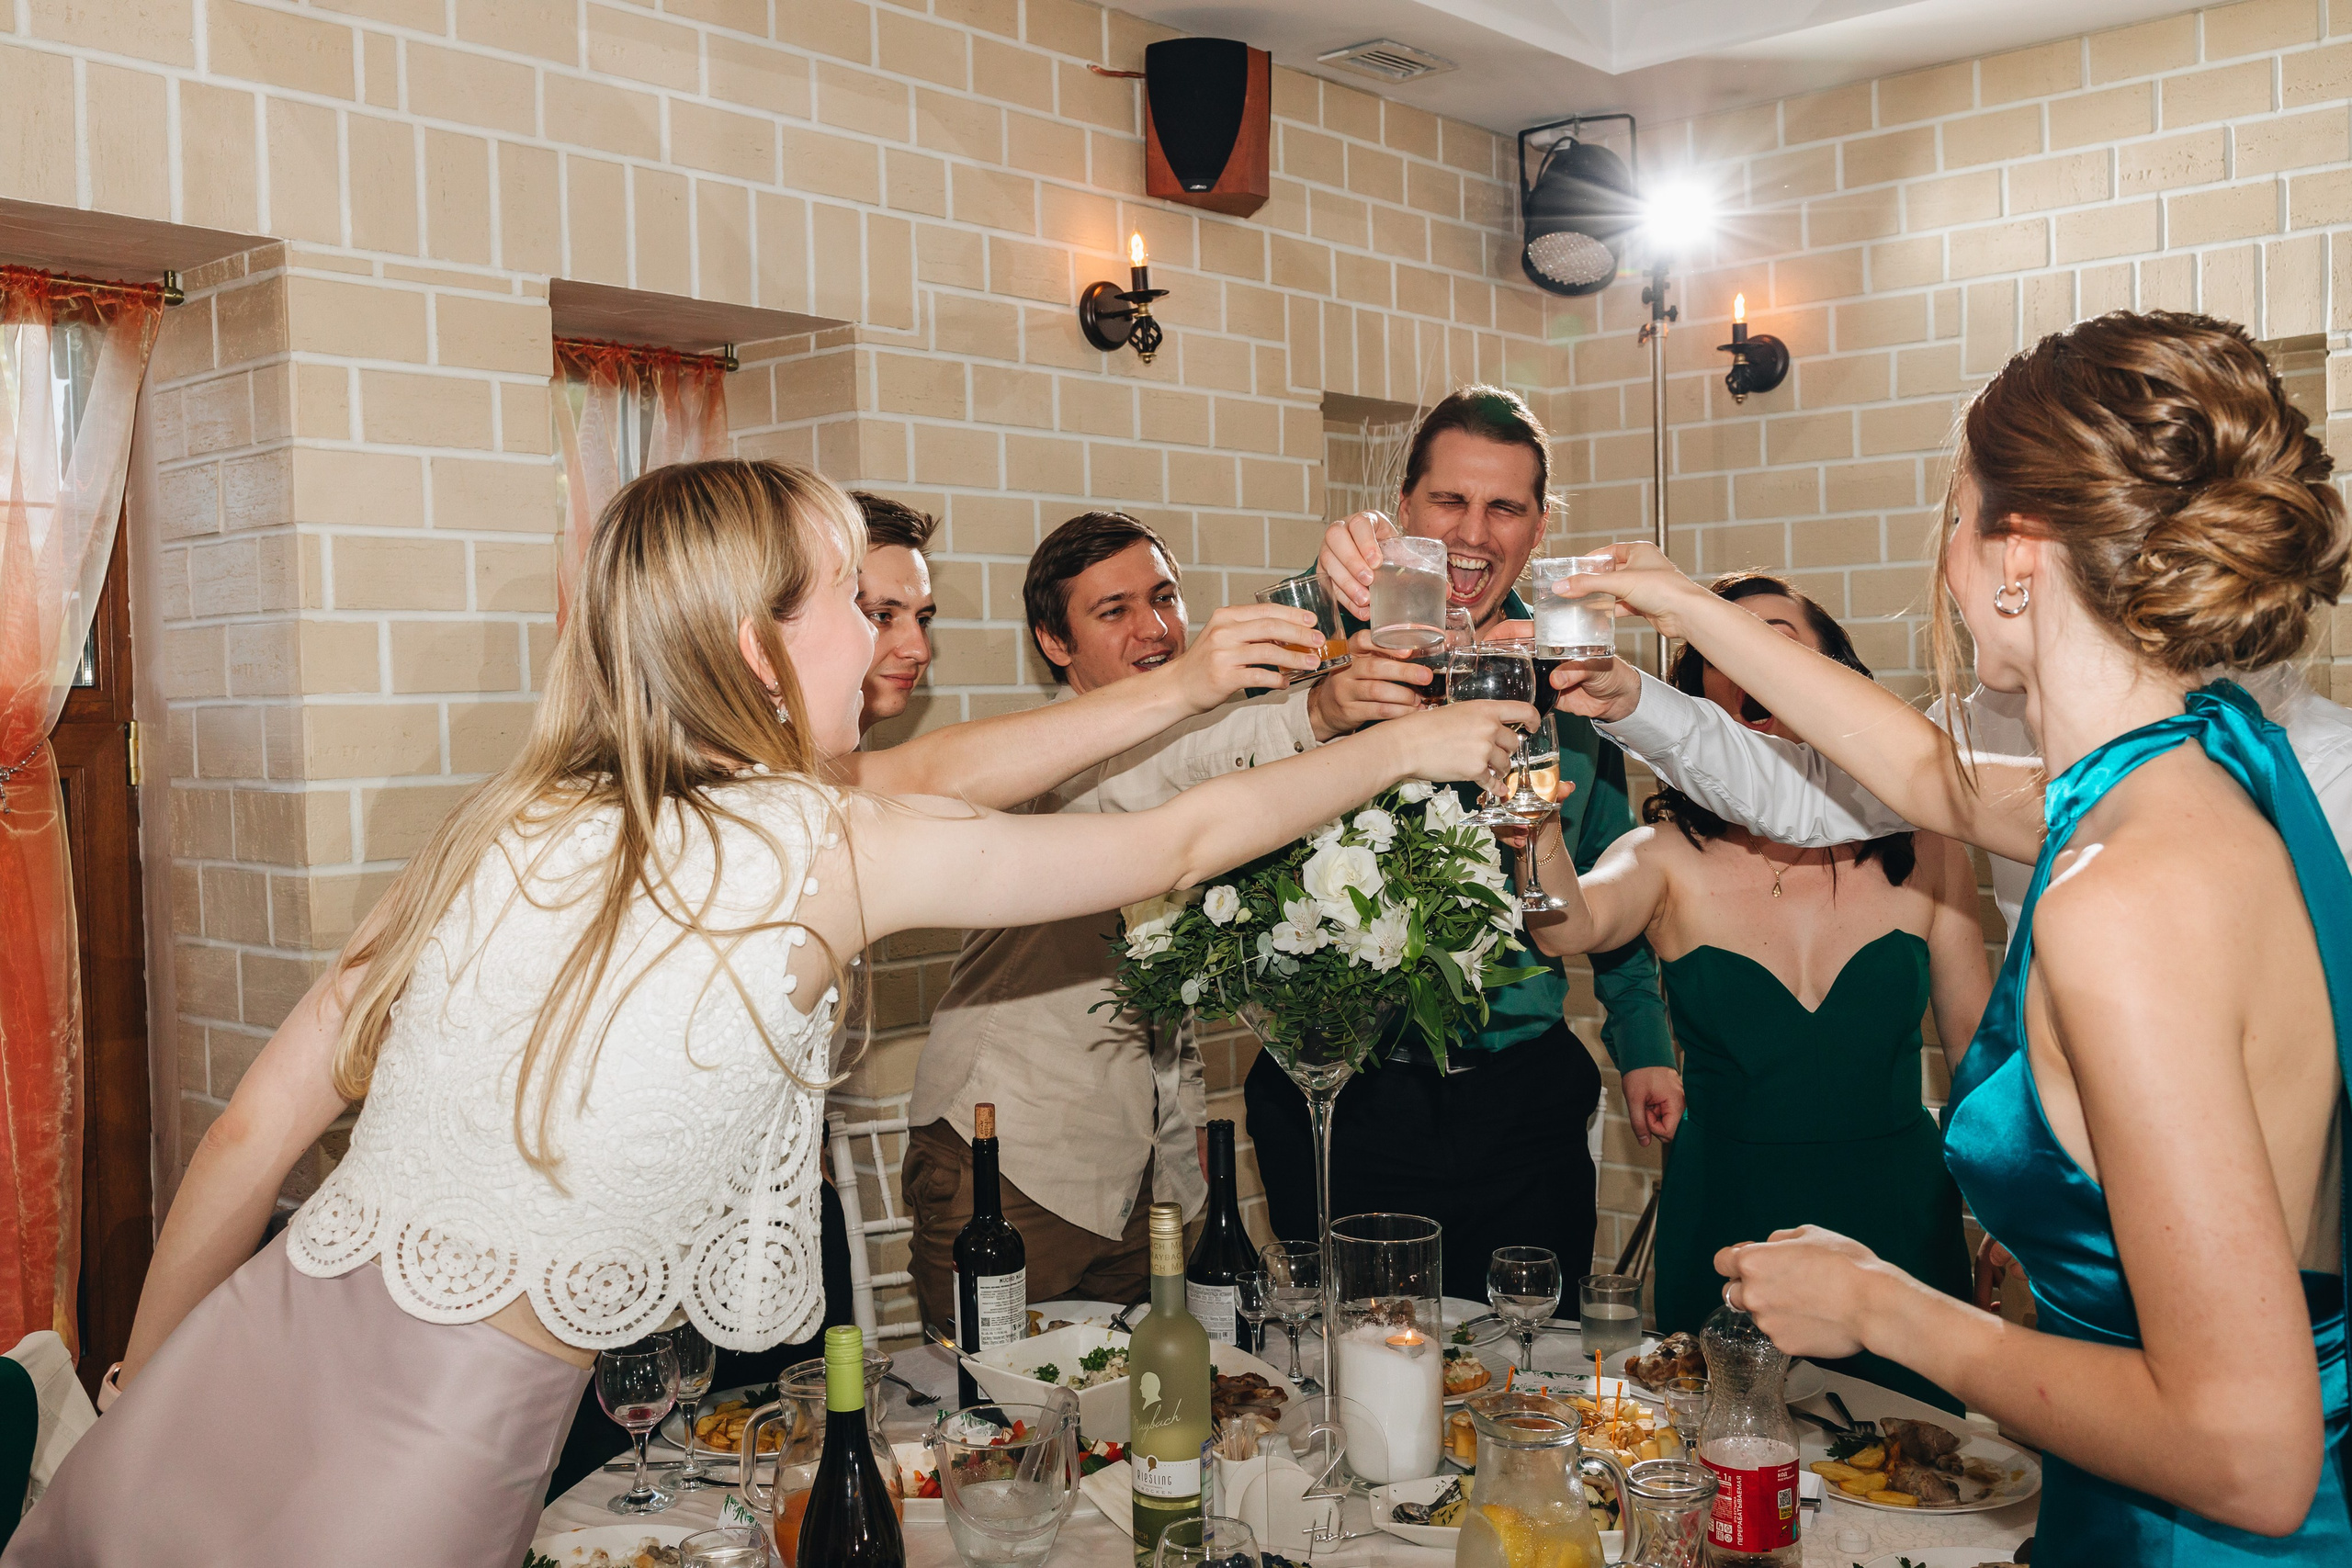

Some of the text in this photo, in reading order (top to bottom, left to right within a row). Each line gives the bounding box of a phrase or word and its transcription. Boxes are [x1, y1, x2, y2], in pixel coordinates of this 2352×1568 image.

[1131, 1398, 1182, 1444] Maybach
[1137, 1484, 1172, 1495] TROCKEN
[1302, 1421, 1356, 1501] 2
[1736, 1475, 1744, 1545] ПЕРЕРАБАТЫВАЕМАЯ
